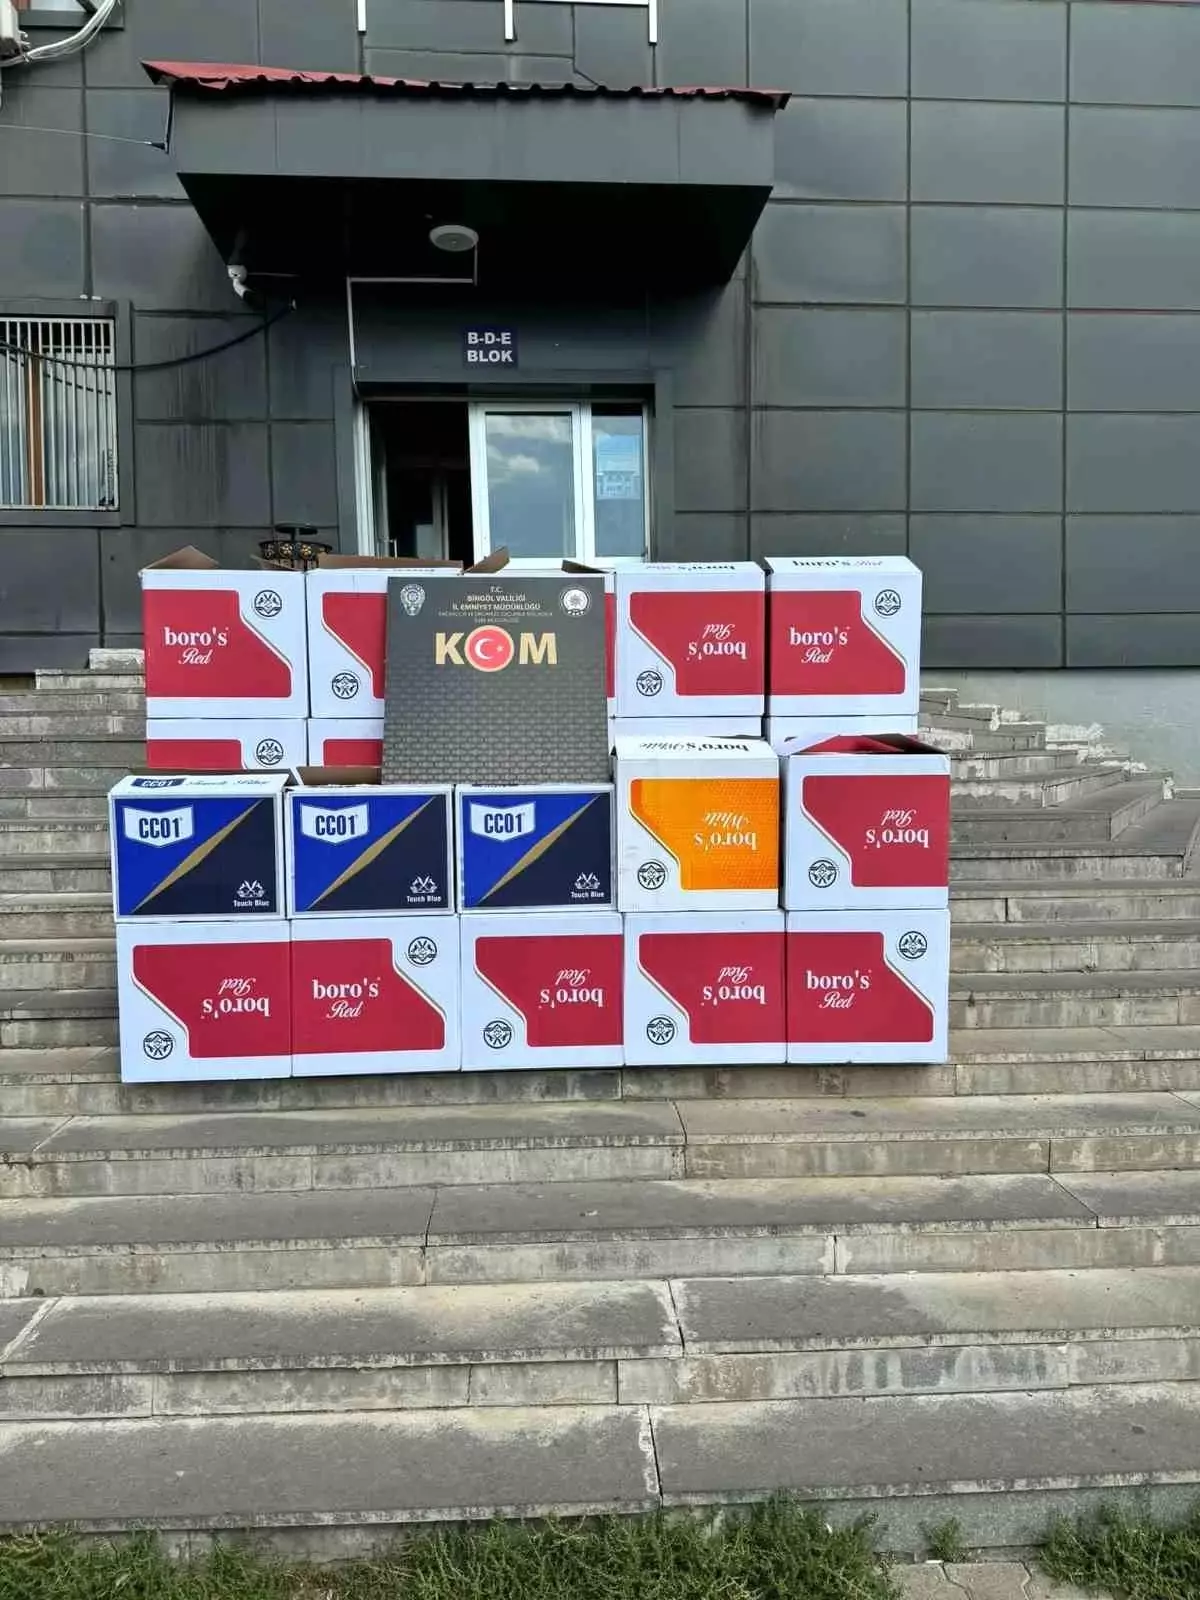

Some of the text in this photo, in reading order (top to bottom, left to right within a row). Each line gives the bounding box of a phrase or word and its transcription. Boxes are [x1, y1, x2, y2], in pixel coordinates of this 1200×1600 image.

[467, 332, 512, 345] B-D-E
[467, 350, 513, 362] BLOK
[164, 626, 228, 647] boro's
[703, 623, 736, 640] Red
[789, 626, 848, 646] boro's
[178, 648, 213, 665] Red
[688, 641, 747, 660] boro's
[801, 648, 833, 664] Red
[881, 808, 917, 826] Red
[694, 832, 757, 850] boro's
[866, 829, 930, 849] boro's
[233, 899, 270, 907] Touch Blue
[571, 890, 605, 899] Touch Blue
[555, 968, 591, 986] Red
[718, 966, 753, 983] Red
[806, 970, 870, 990] boro's
[218, 976, 255, 995] Red
[312, 979, 379, 1000] boro's
[540, 988, 604, 1008] boro's
[703, 985, 767, 1006] boro's
[818, 992, 854, 1010] Red
[203, 997, 270, 1019] boro's
[326, 1000, 362, 1019] Red
